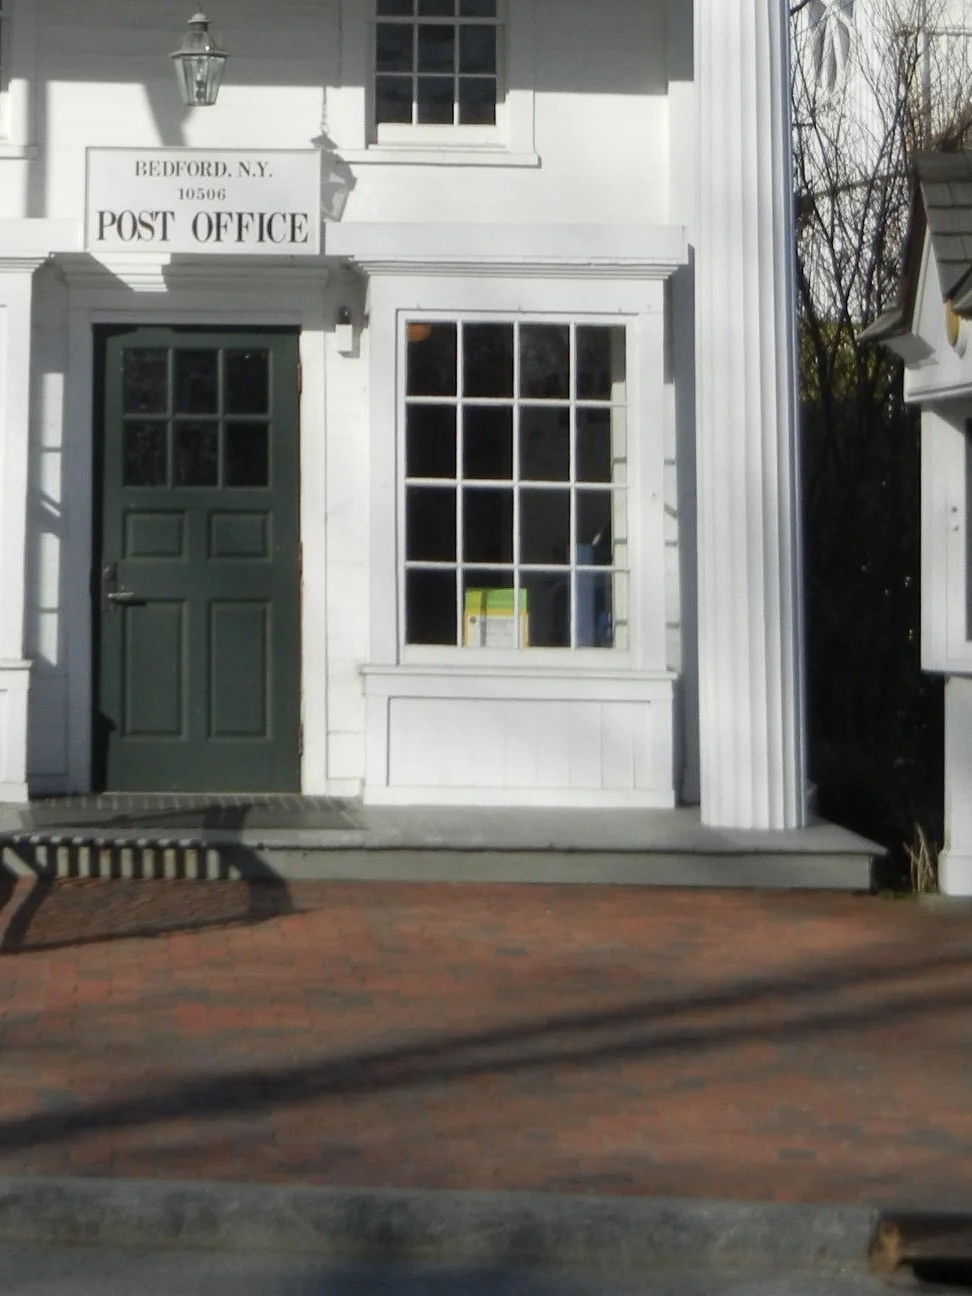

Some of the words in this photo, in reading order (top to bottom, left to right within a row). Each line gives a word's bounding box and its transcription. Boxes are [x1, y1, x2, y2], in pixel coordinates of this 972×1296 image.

[237, 161, 273, 178] N.Y.
[178, 188, 226, 201] 10506
[96, 210, 175, 242] POST
[191, 211, 309, 244] OFFICE
